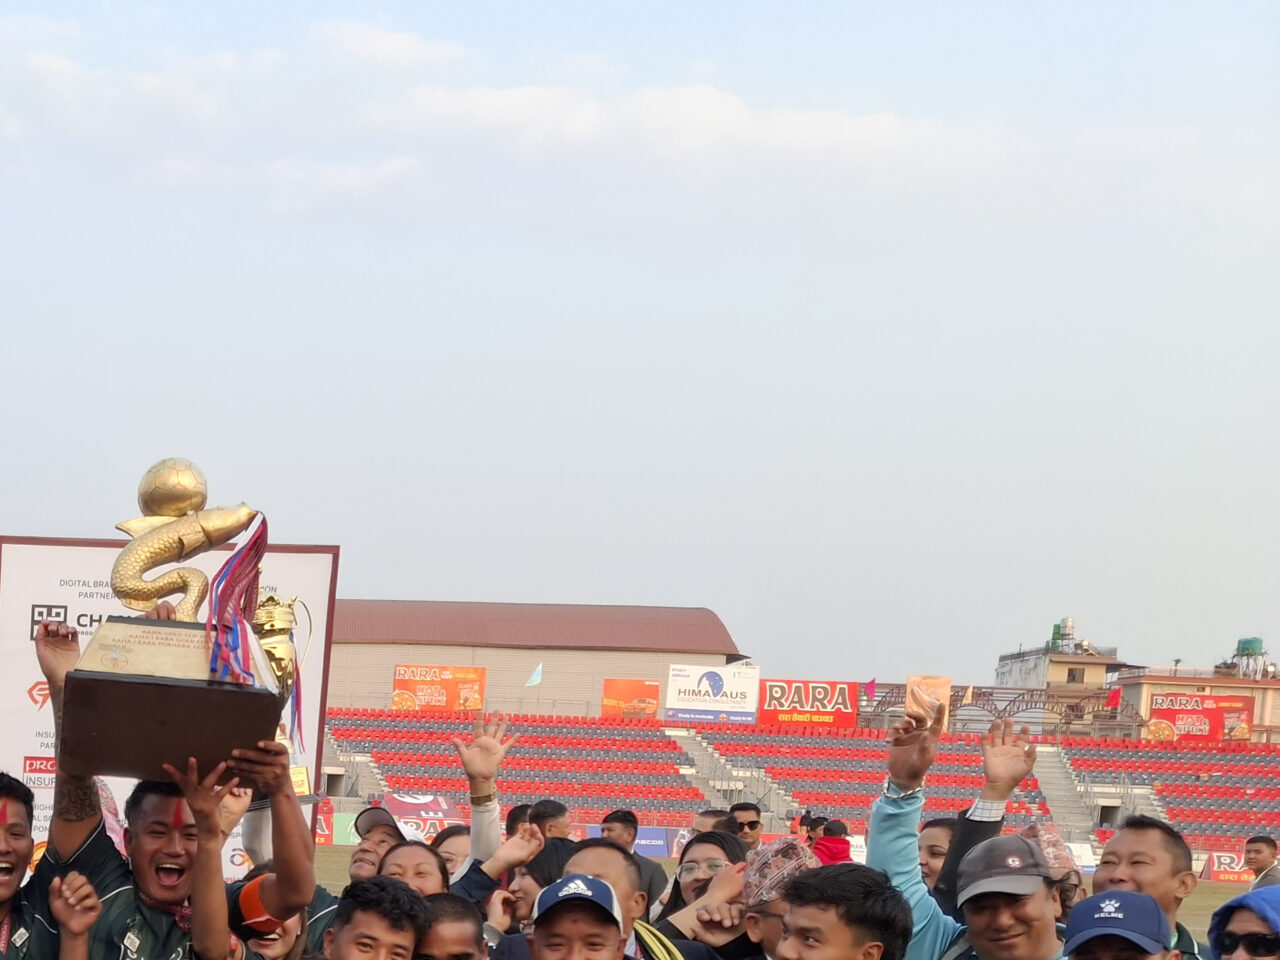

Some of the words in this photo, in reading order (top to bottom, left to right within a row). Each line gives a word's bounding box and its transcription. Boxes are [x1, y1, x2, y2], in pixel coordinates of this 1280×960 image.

[59, 579, 92, 588] DIGITAL
[93, 580, 110, 588] BRA
[396, 667, 441, 681] RARA
[764, 682, 853, 712] RARA
[1152, 696, 1202, 710] RARA
